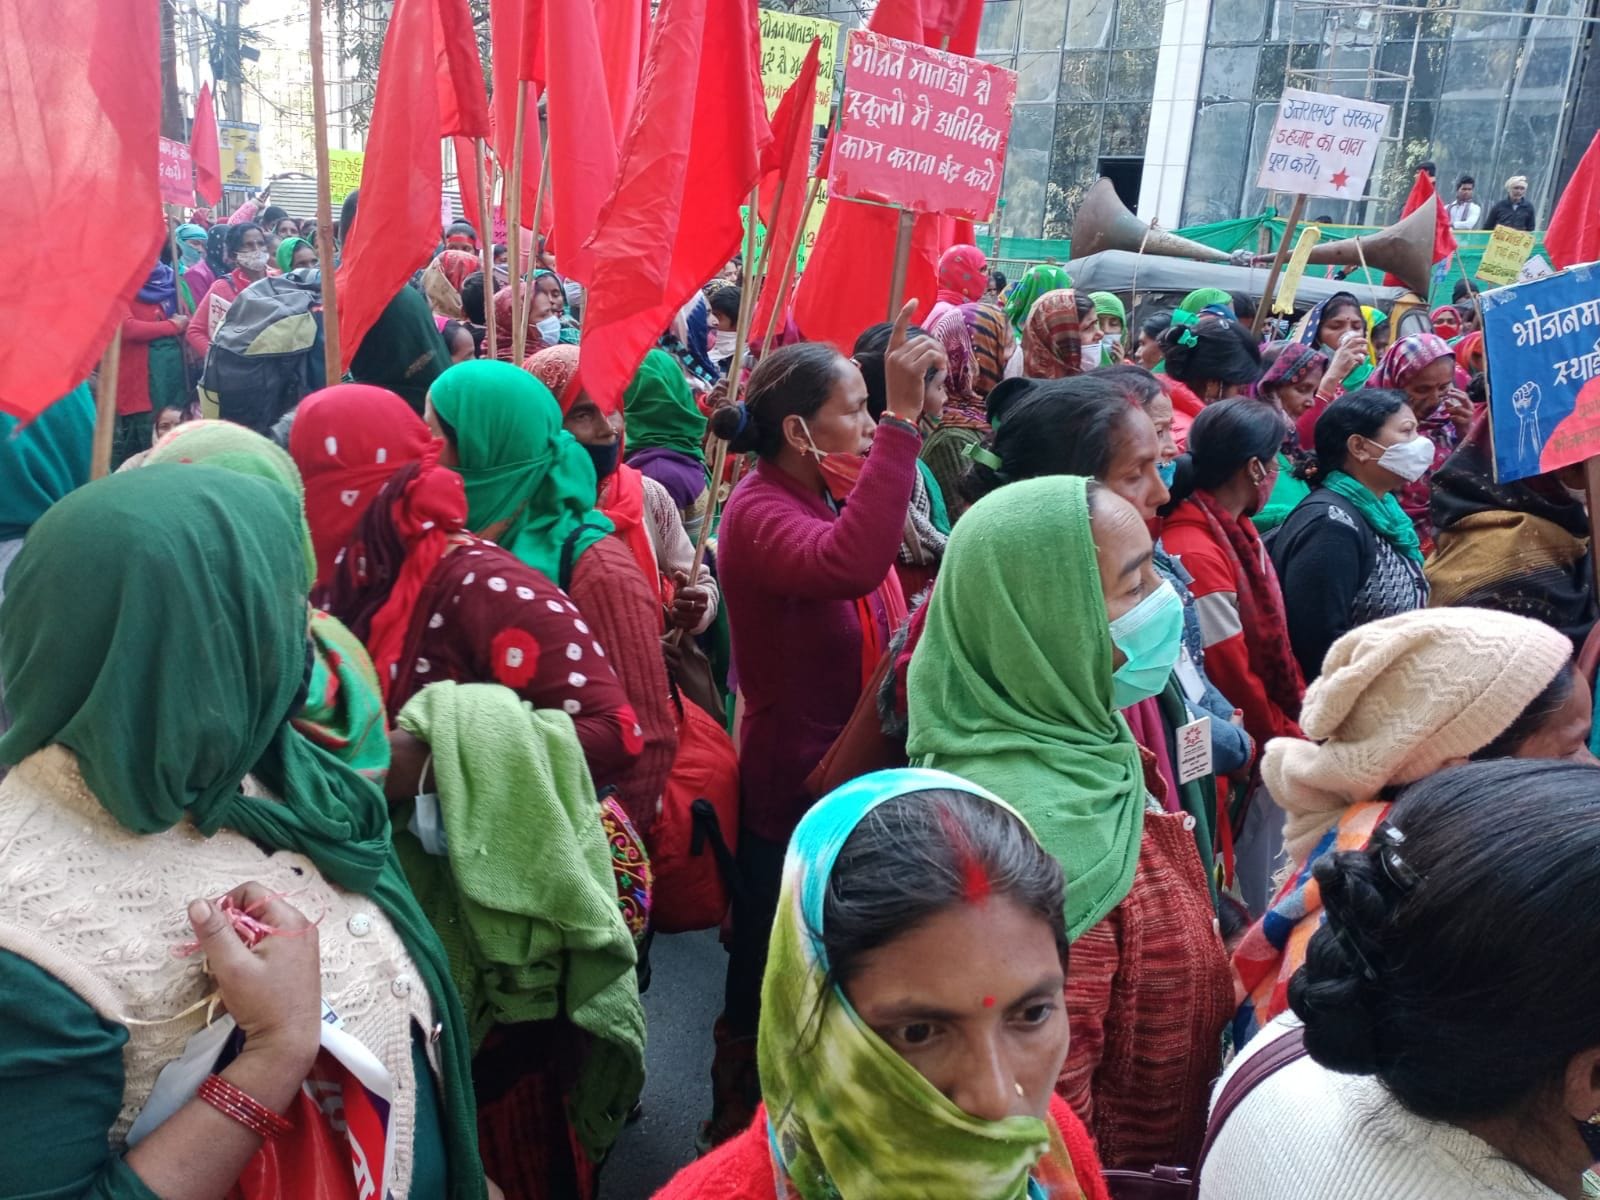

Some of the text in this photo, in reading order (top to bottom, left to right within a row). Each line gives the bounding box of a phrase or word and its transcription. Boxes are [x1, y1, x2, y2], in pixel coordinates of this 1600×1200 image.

[907, 58, 974, 97] माताओं
[973, 69, 992, 105] से
[1343, 108, 1385, 133] सरकार
[839, 134, 996, 192] काम कराना बंद करो
[1268, 152, 1289, 173] पूरा
[1339, 136, 1366, 157] वादा
[1512, 298, 1600, 347] भोजनम
